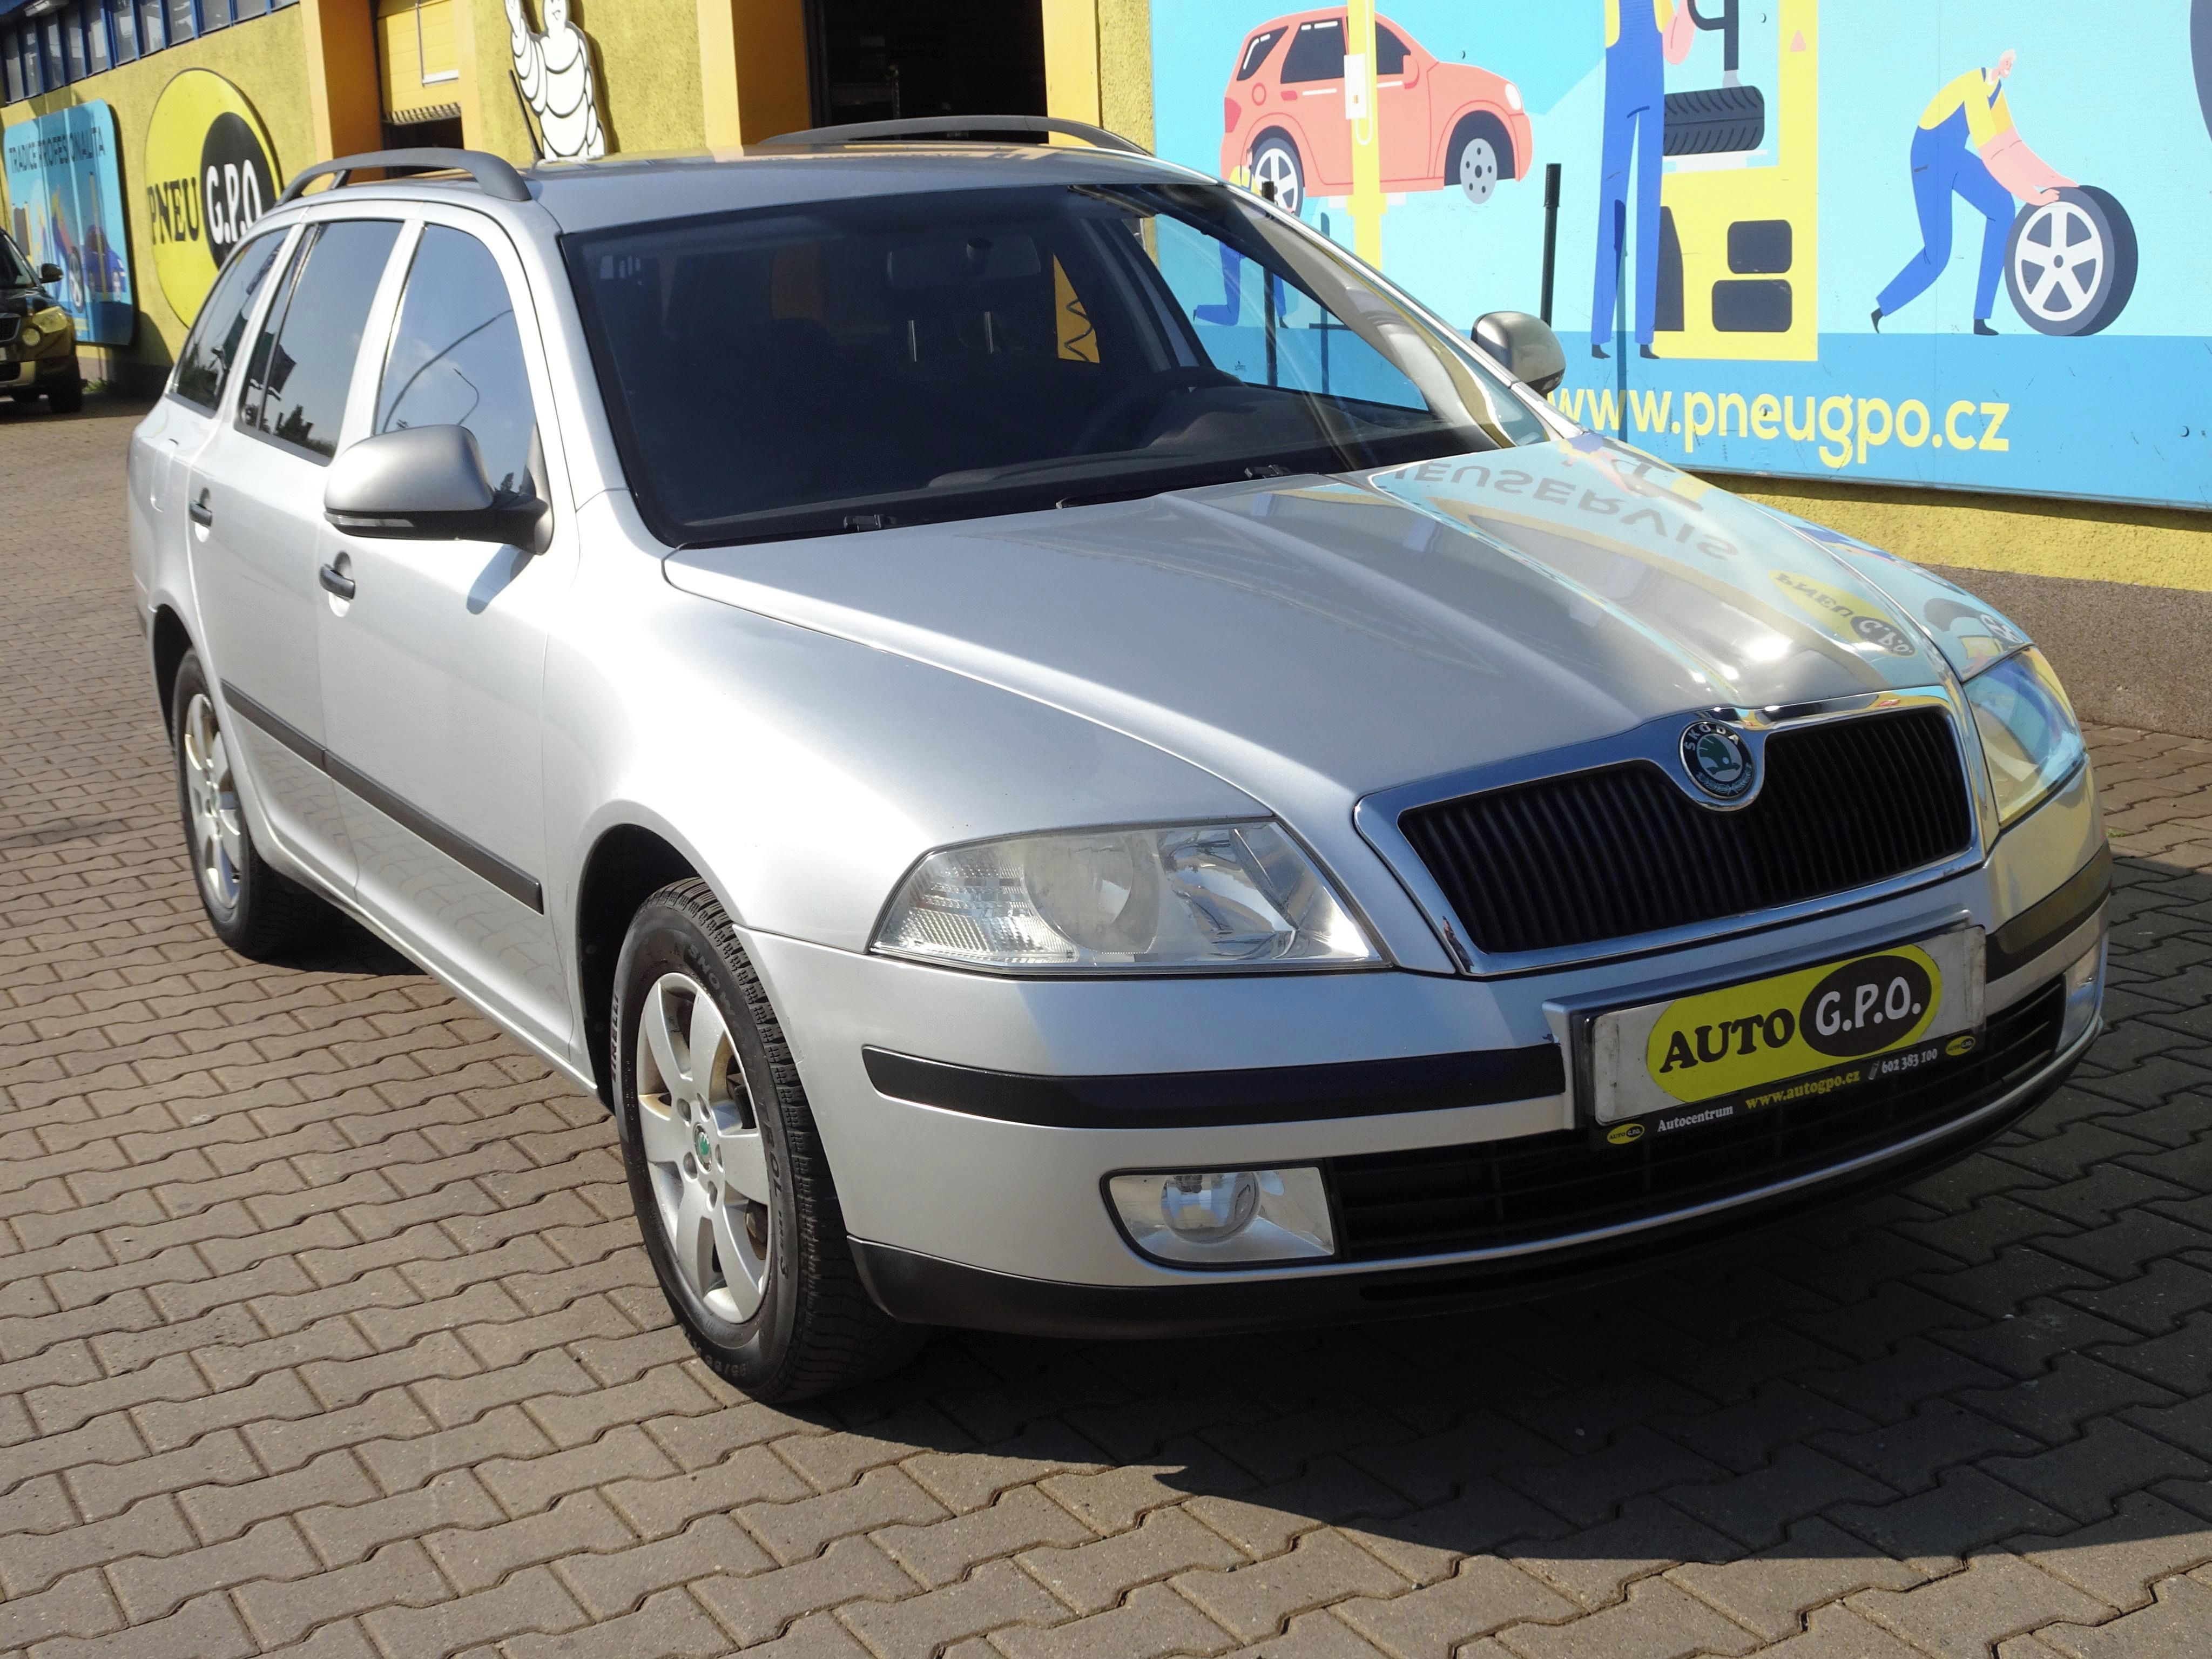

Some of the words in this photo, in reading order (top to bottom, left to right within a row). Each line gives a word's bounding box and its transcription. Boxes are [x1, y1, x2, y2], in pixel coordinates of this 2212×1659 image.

[147, 177, 199, 245] PNEU
[1547, 388, 2009, 469] www.pneugpo.cz
[1660, 1008, 1796, 1074] AUTO
[1815, 976, 1922, 1037] G.P.O.
[1657, 1105, 1734, 1132] Autocentrum
[1745, 1070, 1860, 1110] www.autogpo.cz
[1881, 1058, 1900, 1074] 602
[1901, 1054, 1919, 1070] 383
[1921, 1048, 1938, 1063] 100
